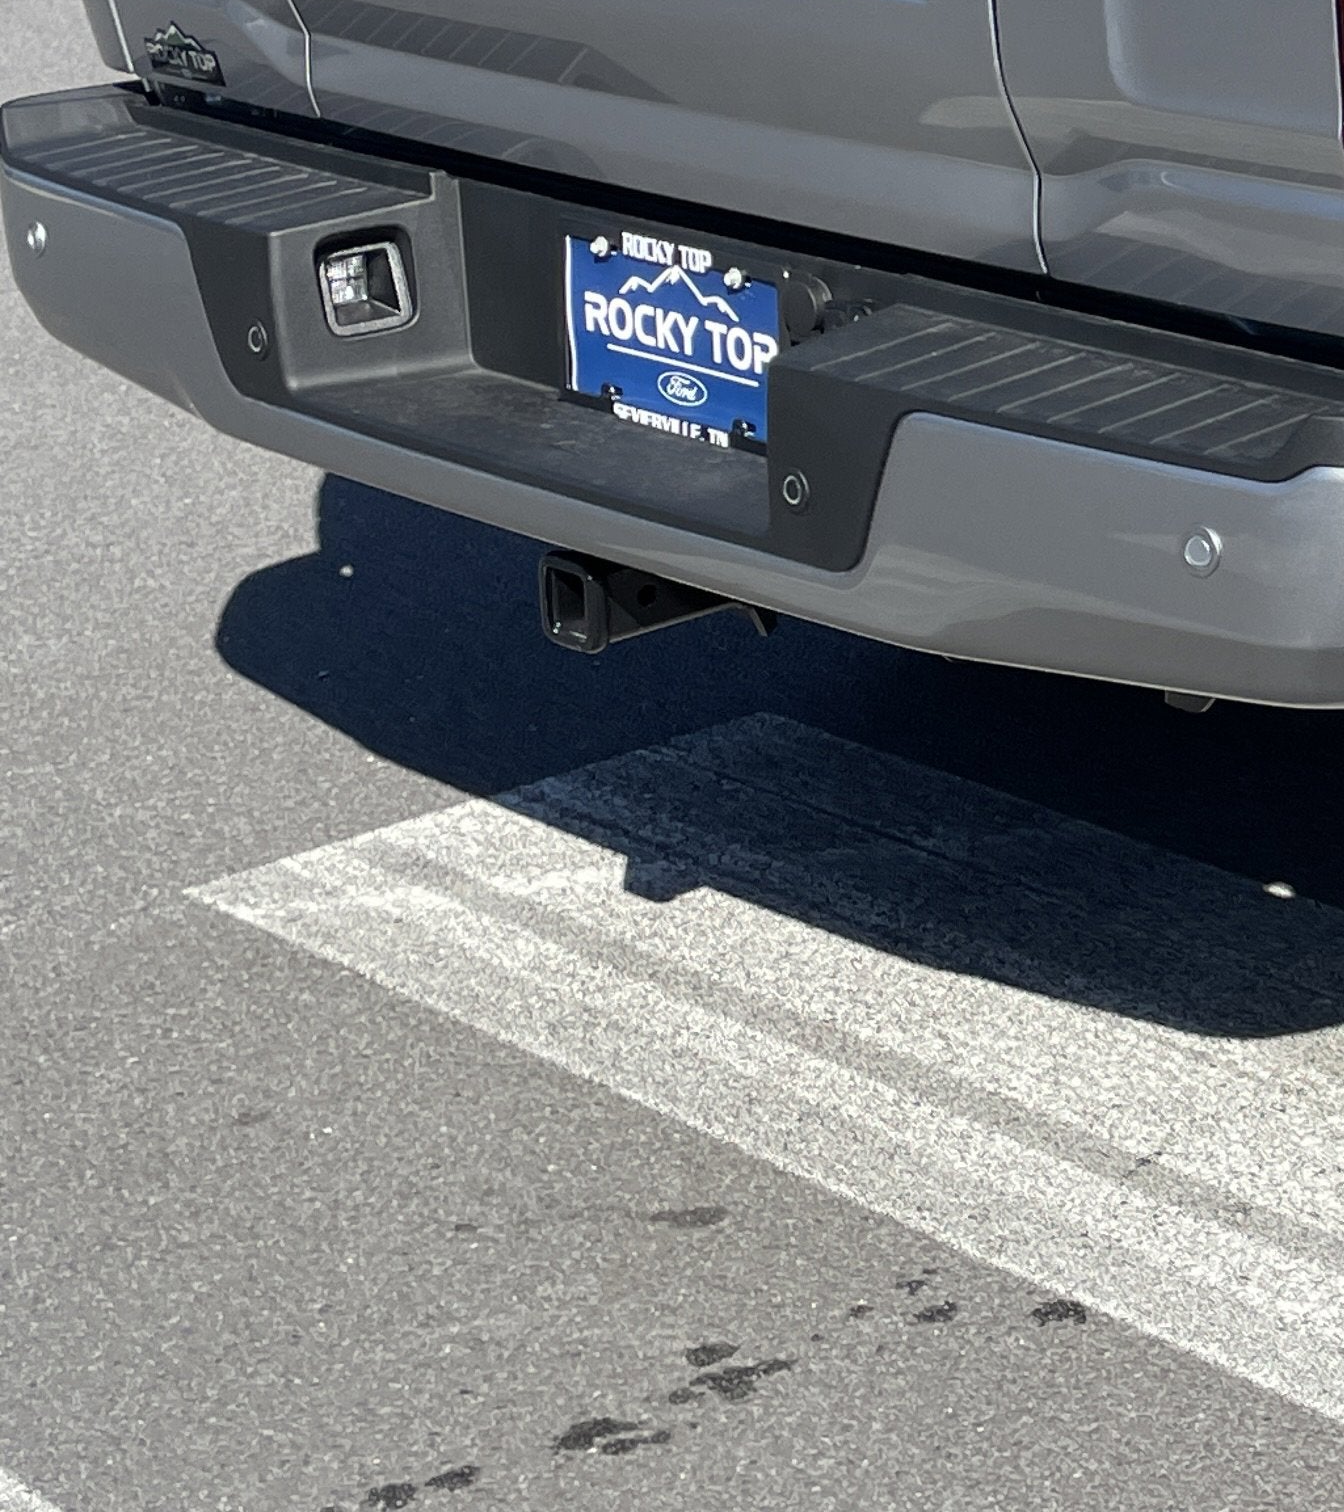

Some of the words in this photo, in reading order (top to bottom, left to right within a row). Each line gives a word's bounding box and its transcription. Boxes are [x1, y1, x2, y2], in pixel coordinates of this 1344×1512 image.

[188, 50, 216, 72] TOP
[622, 231, 674, 265] ROCKY
[678, 245, 712, 273] TOP
[584, 291, 699, 356] ROCKY
[705, 320, 778, 374] TOP
[666, 376, 698, 401] Ford
[707, 427, 729, 448] TN
